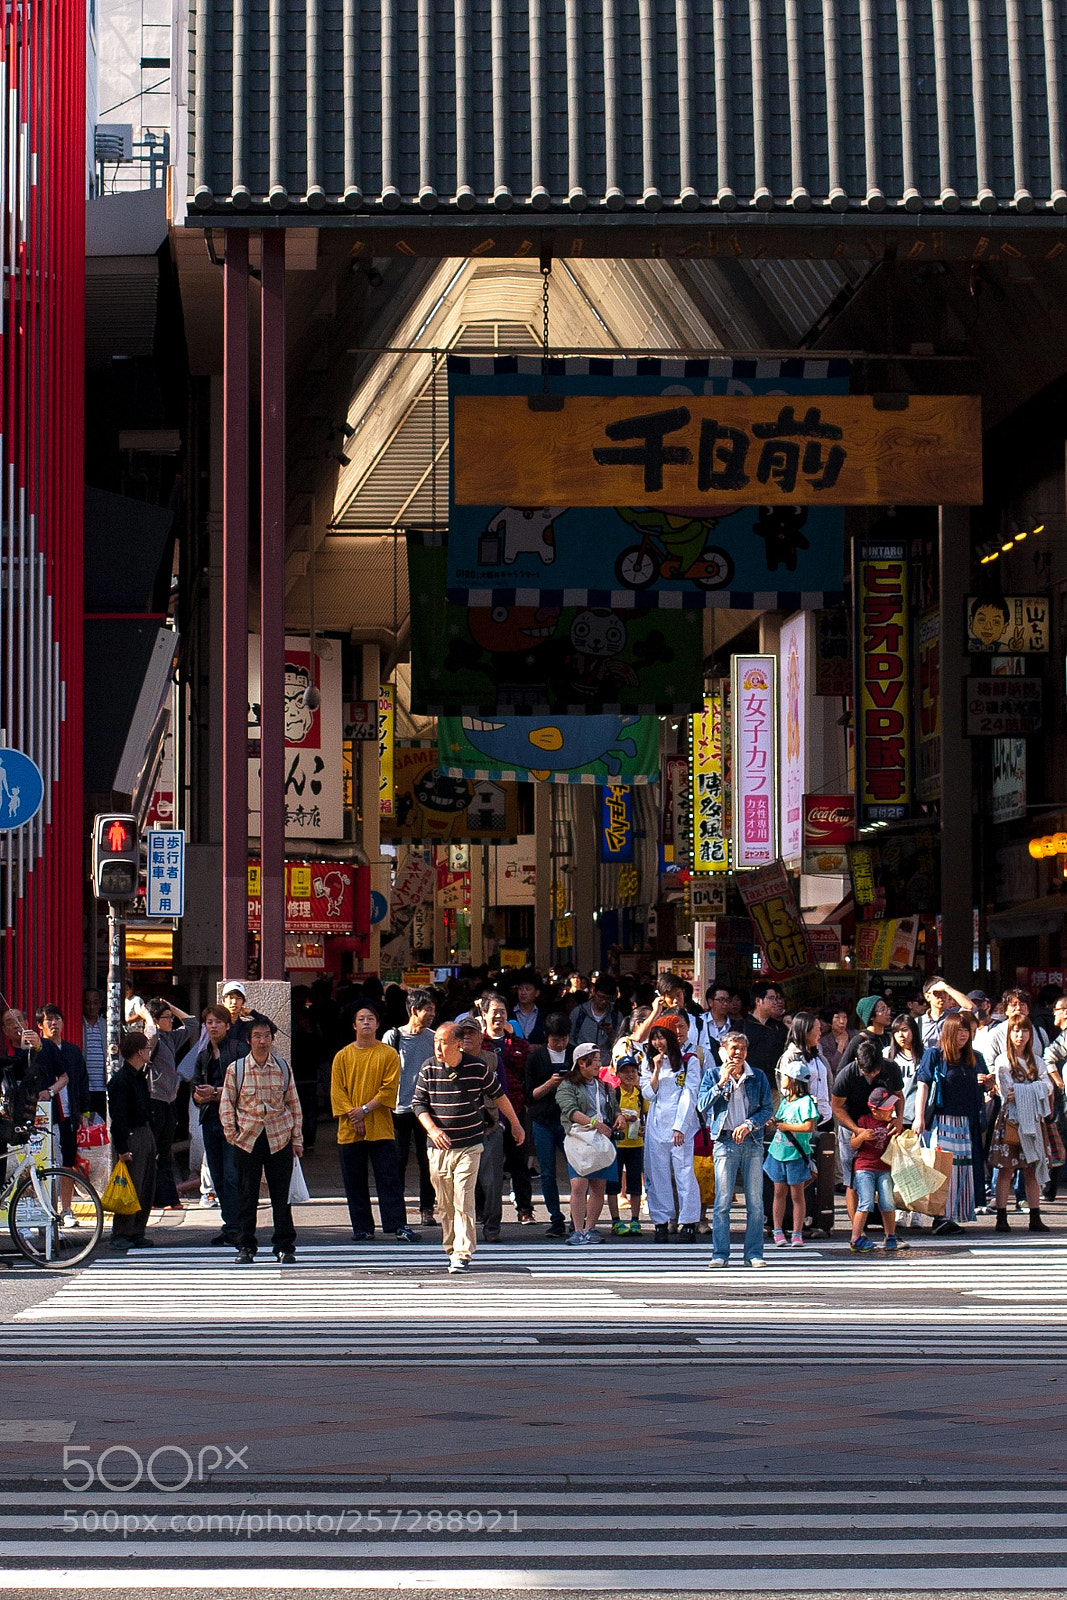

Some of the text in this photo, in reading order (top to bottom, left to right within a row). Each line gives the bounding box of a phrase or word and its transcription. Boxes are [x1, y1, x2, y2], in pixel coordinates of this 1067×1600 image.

[593, 406, 847, 492] 千日前
[743, 693, 768, 792] 女子カラ
[696, 772, 726, 864] 博多風龍
[746, 799, 756, 839] カラオケ
[757, 799, 767, 839] 女性専用
[152, 836, 165, 879] 自転車
[166, 836, 180, 879] 歩行者
[159, 882, 171, 911] 専用
[287, 901, 311, 918] 修理
[767, 933, 808, 971] OFF
